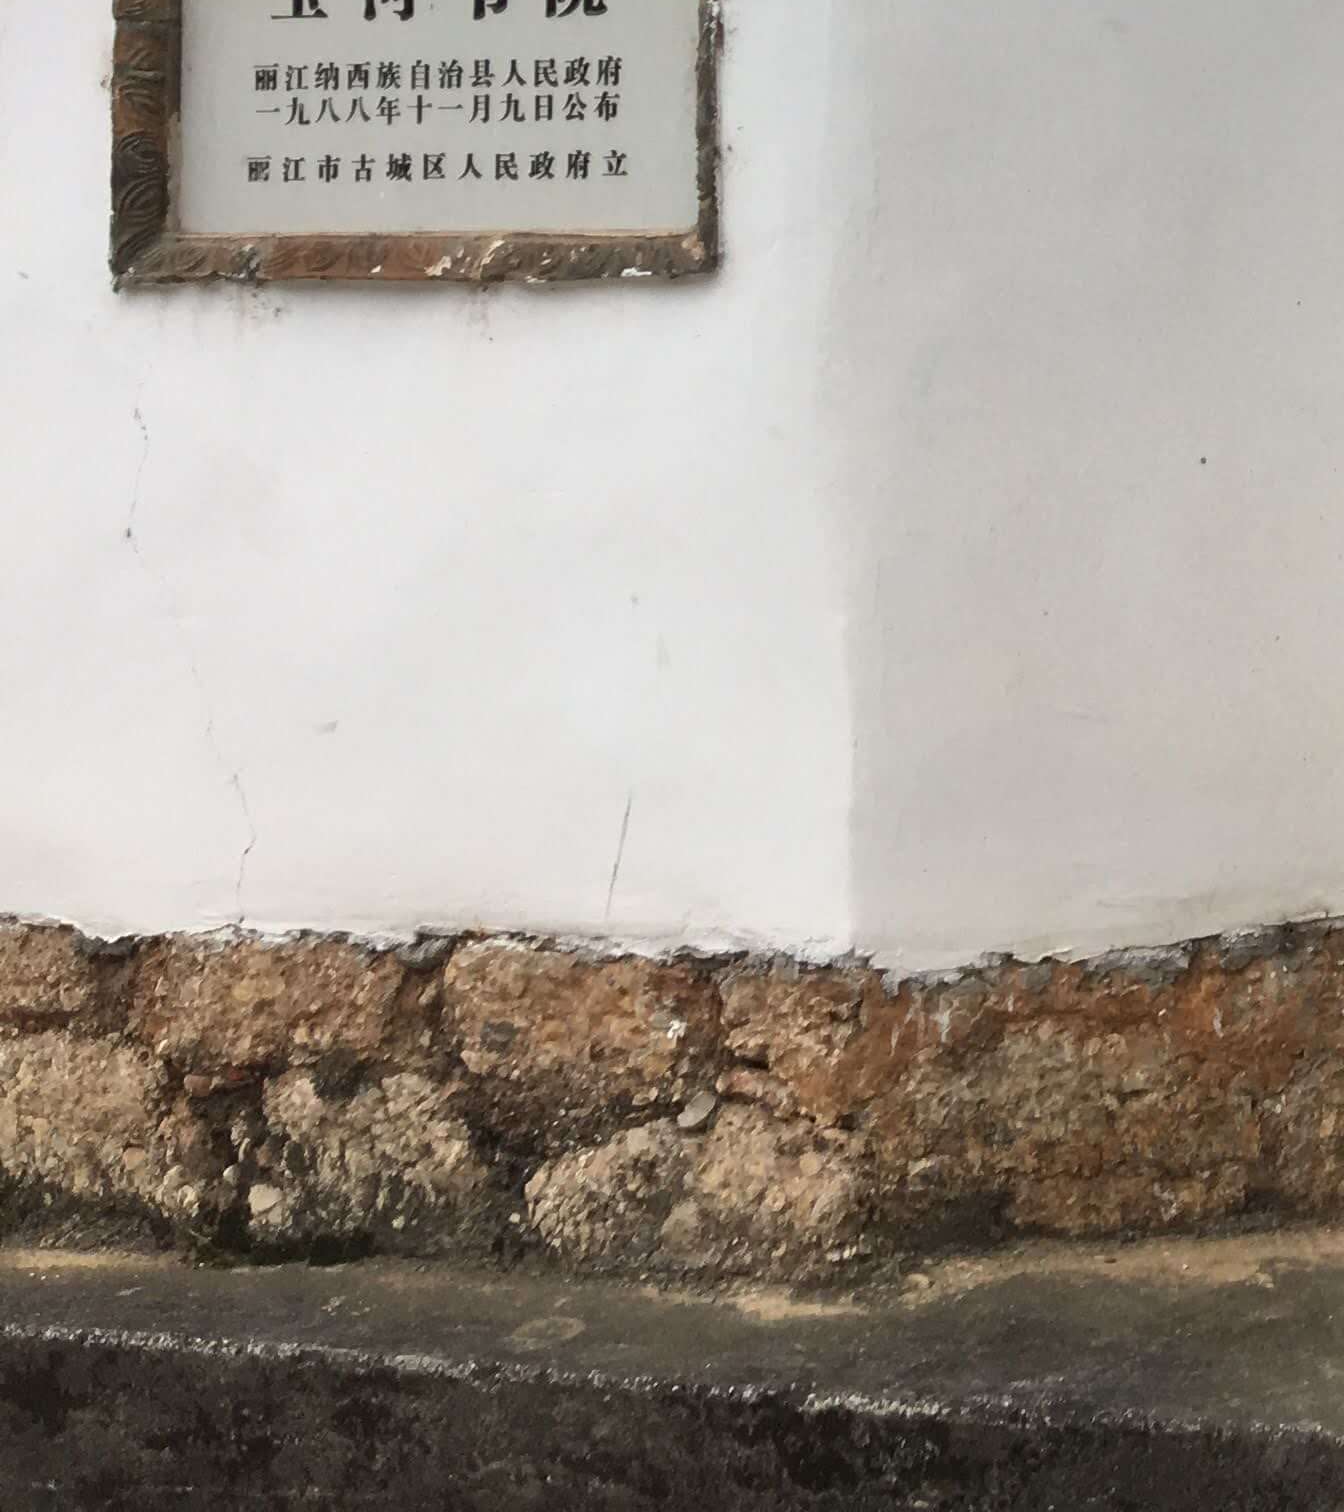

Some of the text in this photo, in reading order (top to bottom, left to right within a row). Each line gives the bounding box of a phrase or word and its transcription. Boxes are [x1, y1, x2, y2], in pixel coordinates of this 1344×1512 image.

[254, 55, 623, 92] 丽江纳西族自治县人民政府
[255, 91, 621, 126] 一九八八年十一月九日公布
[247, 149, 629, 183] 丽江市古城区人民政府立
